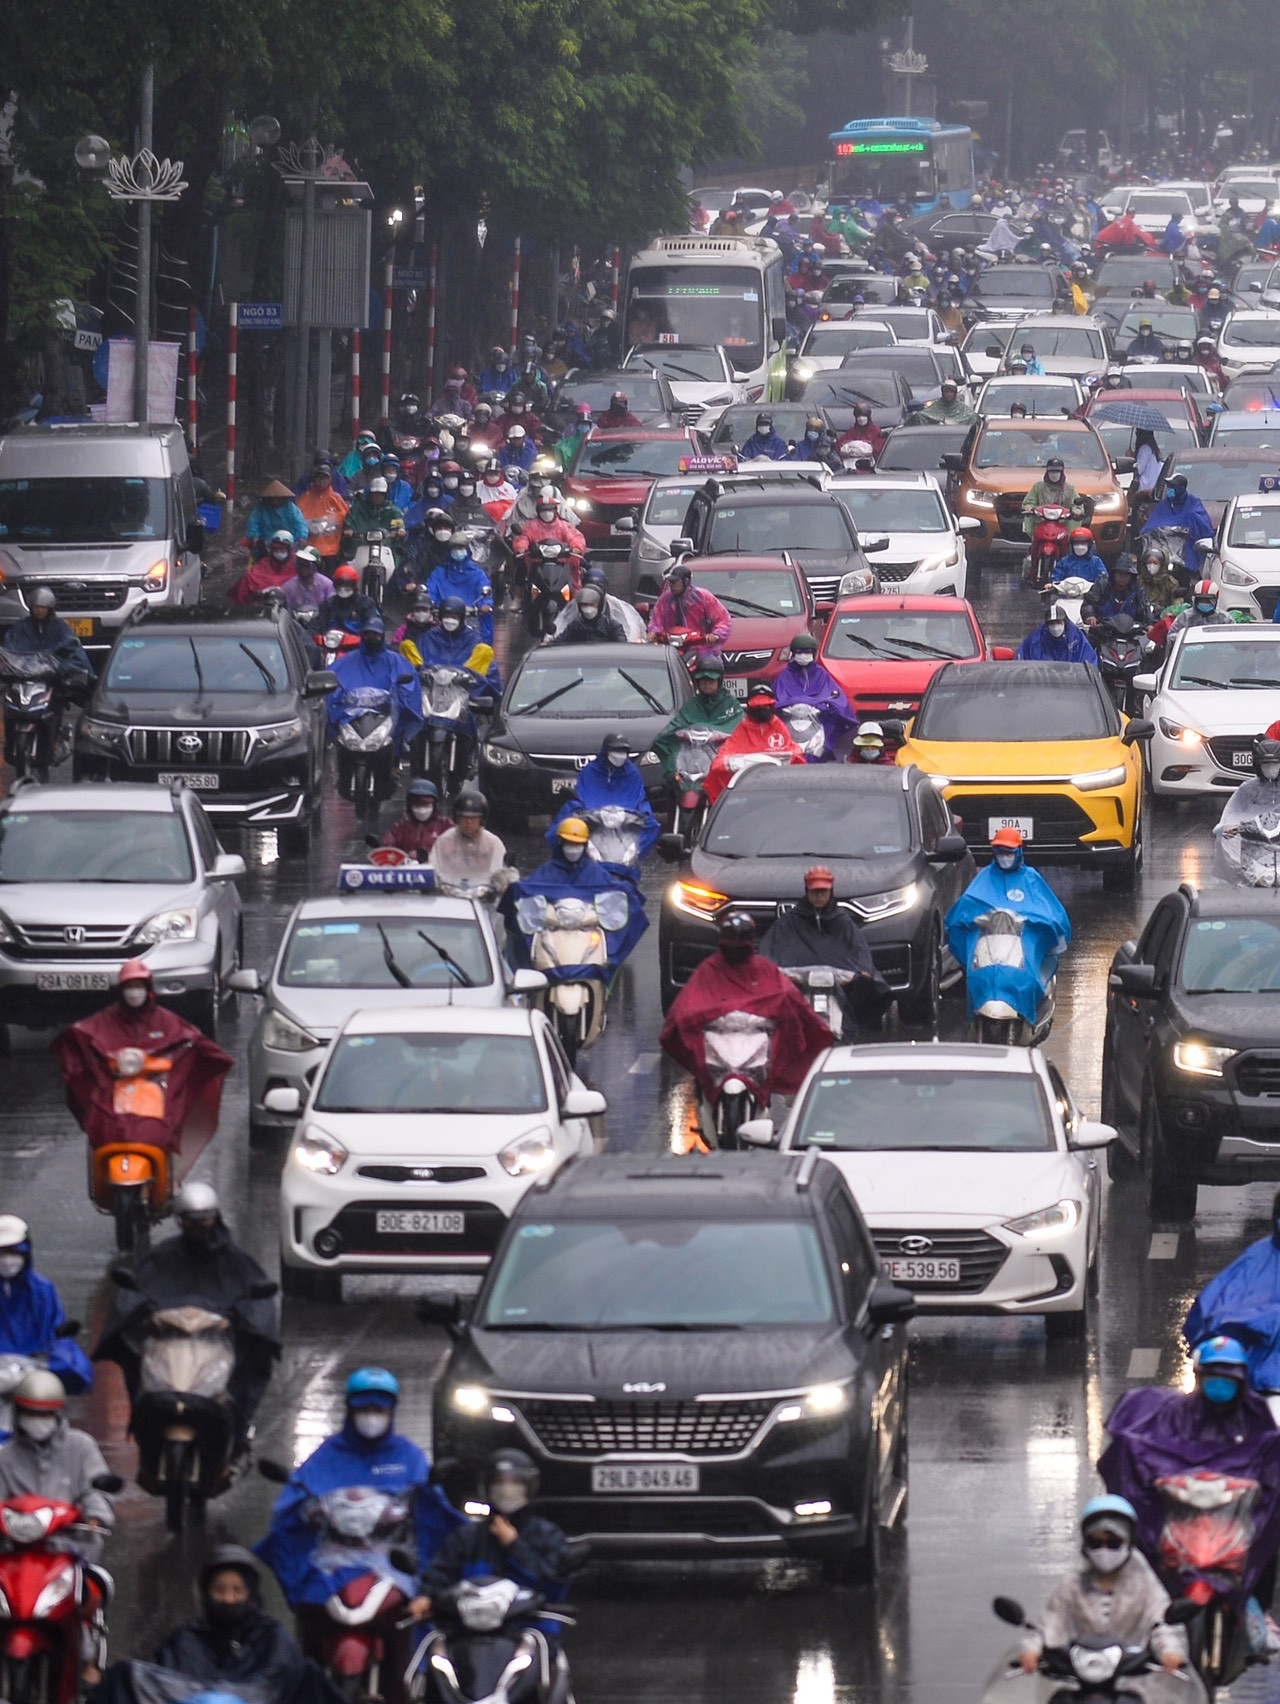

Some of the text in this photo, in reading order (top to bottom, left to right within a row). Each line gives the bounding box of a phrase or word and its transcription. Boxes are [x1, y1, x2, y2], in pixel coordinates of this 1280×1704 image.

[1234, 754, 1253, 765] 30G
[1001, 819, 1020, 829] 90A
[881, 1261, 958, 1279] 0E-539.56
